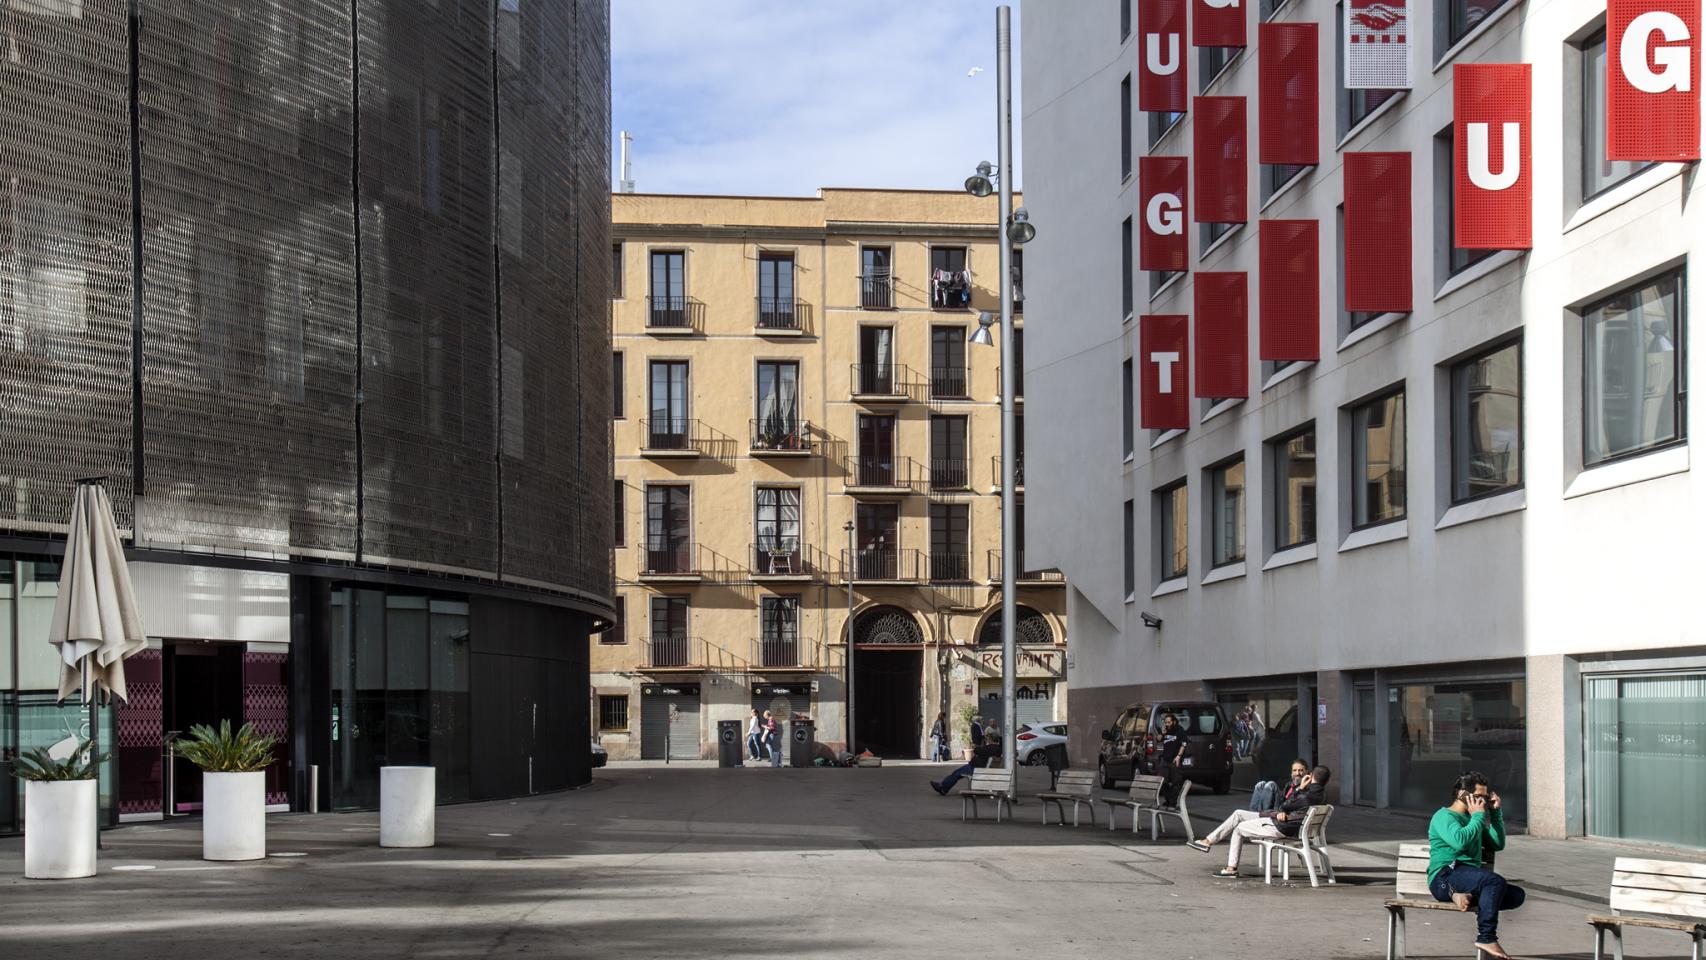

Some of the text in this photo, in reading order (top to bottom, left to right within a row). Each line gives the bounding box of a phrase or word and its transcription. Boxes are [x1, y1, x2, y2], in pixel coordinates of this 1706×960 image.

[1148, 33, 1178, 74] U
[1619, 11, 1692, 92] G
[1467, 122, 1521, 190] U
[1147, 193, 1182, 235] G
[1151, 350, 1179, 394] T
